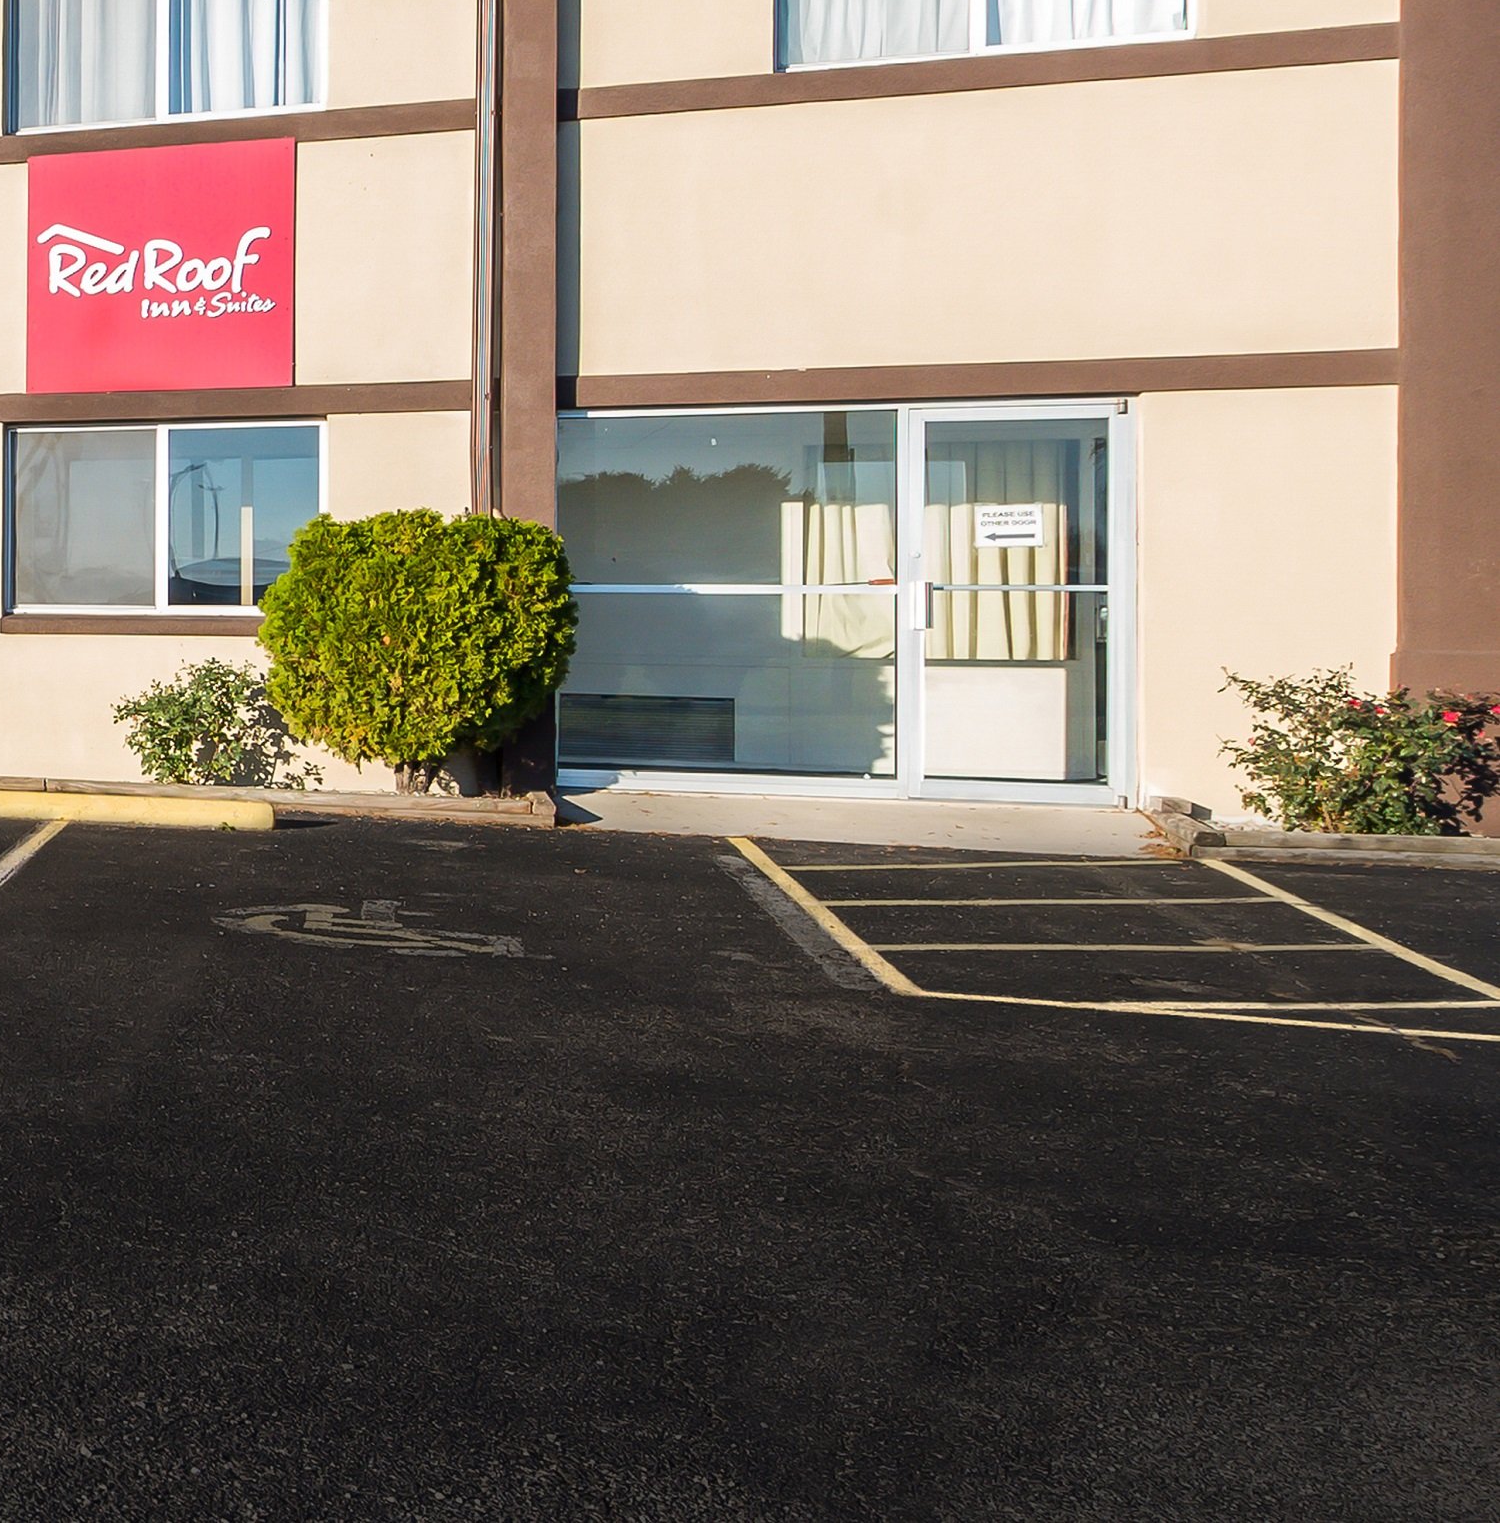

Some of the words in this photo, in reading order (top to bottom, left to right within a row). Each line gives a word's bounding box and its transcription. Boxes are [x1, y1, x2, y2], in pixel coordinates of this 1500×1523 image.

[49, 243, 139, 297] Red
[143, 227, 271, 294] Roof
[141, 299, 191, 318] Inn
[194, 297, 206, 316] &
[207, 291, 276, 317] Suites
